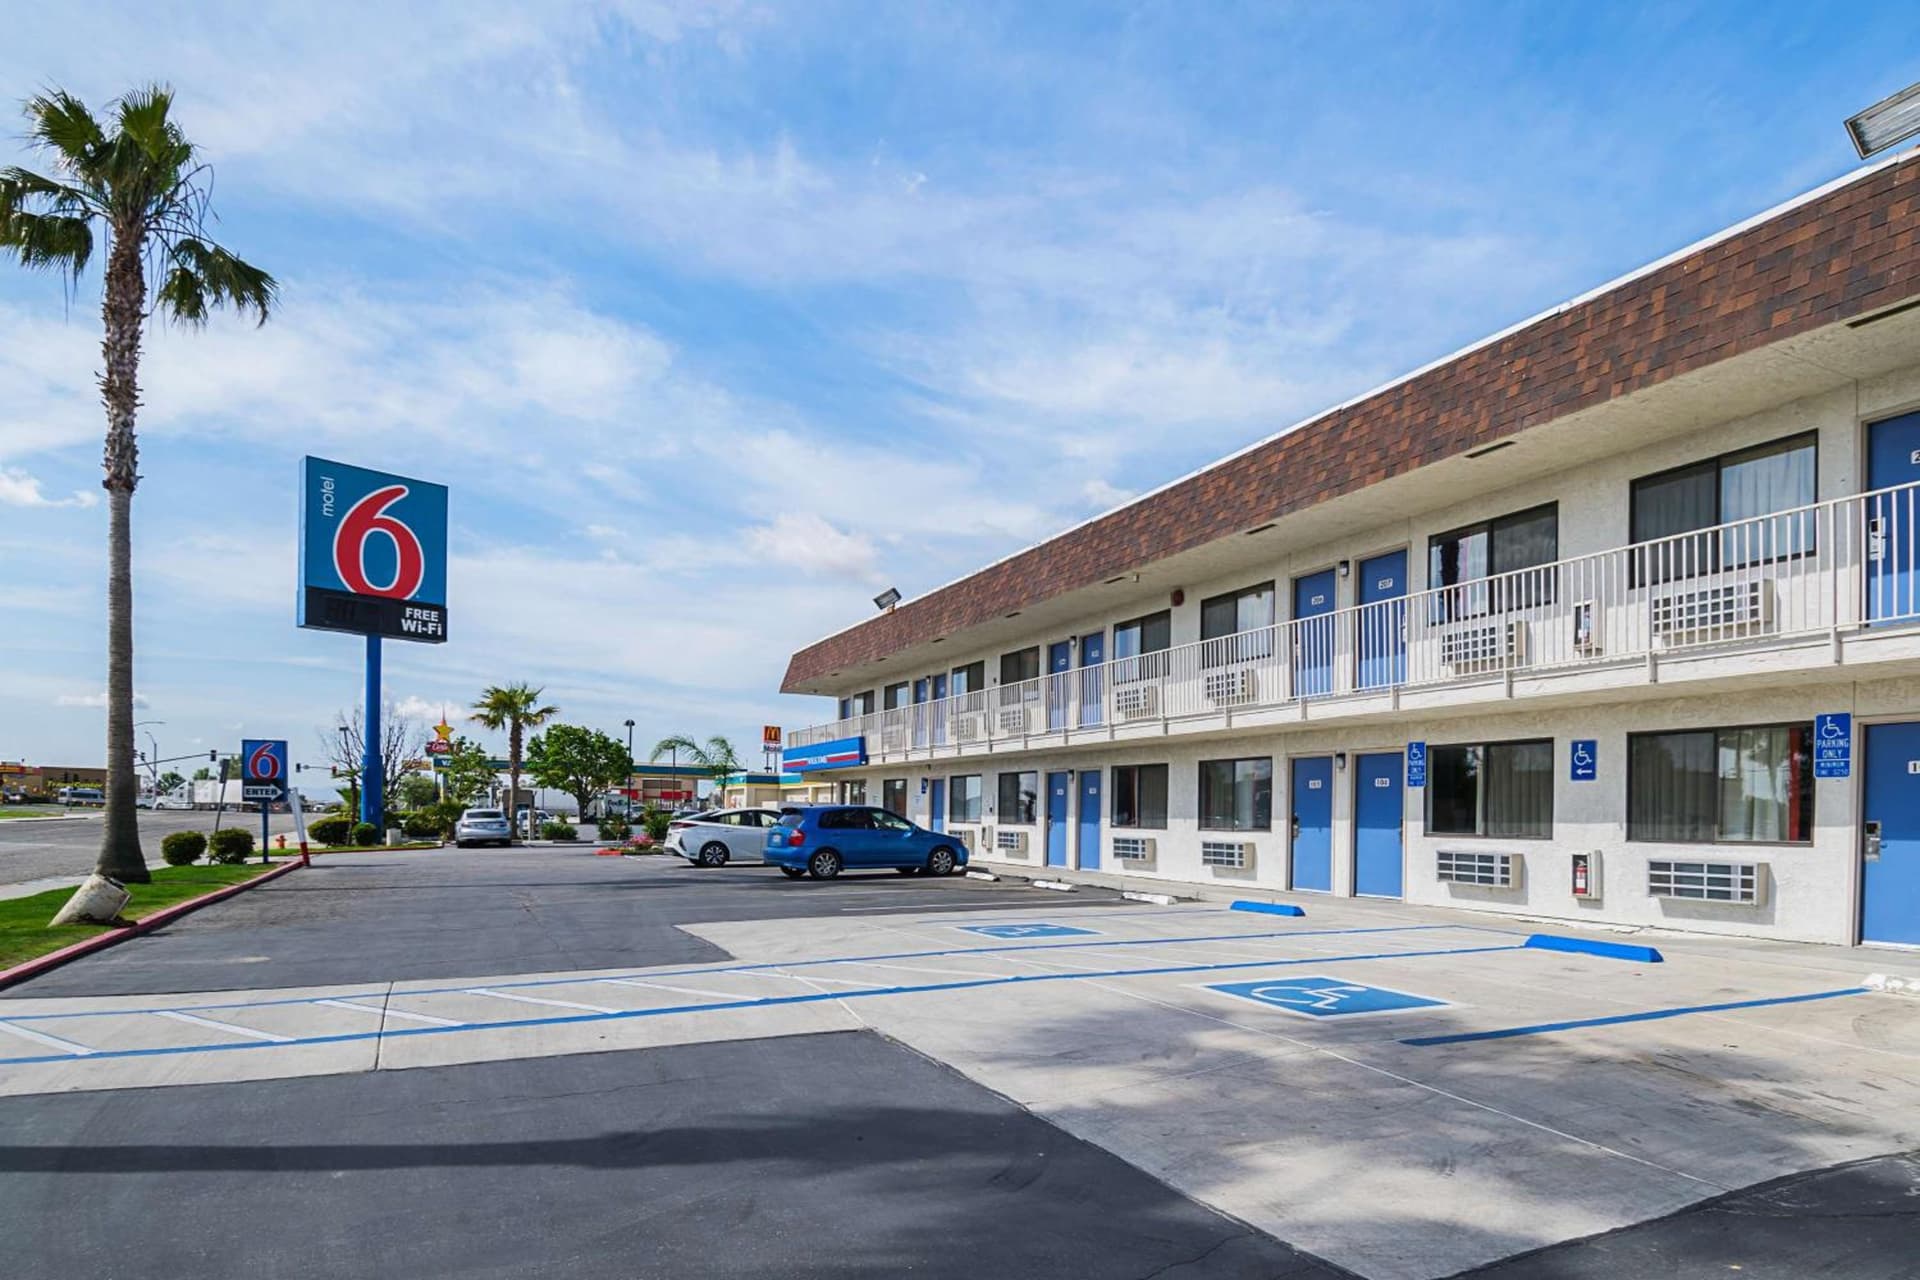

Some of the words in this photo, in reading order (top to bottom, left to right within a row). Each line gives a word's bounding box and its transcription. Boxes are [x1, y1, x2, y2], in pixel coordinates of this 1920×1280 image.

[320, 476, 335, 517] motel
[332, 484, 425, 600] 6
[405, 607, 439, 622] FREE
[401, 618, 441, 636] Wi-Fi
[1816, 738, 1849, 748] PARKING
[249, 743, 280, 780] 6
[1822, 749, 1843, 758] ONLY
[247, 787, 277, 796] ENTER
